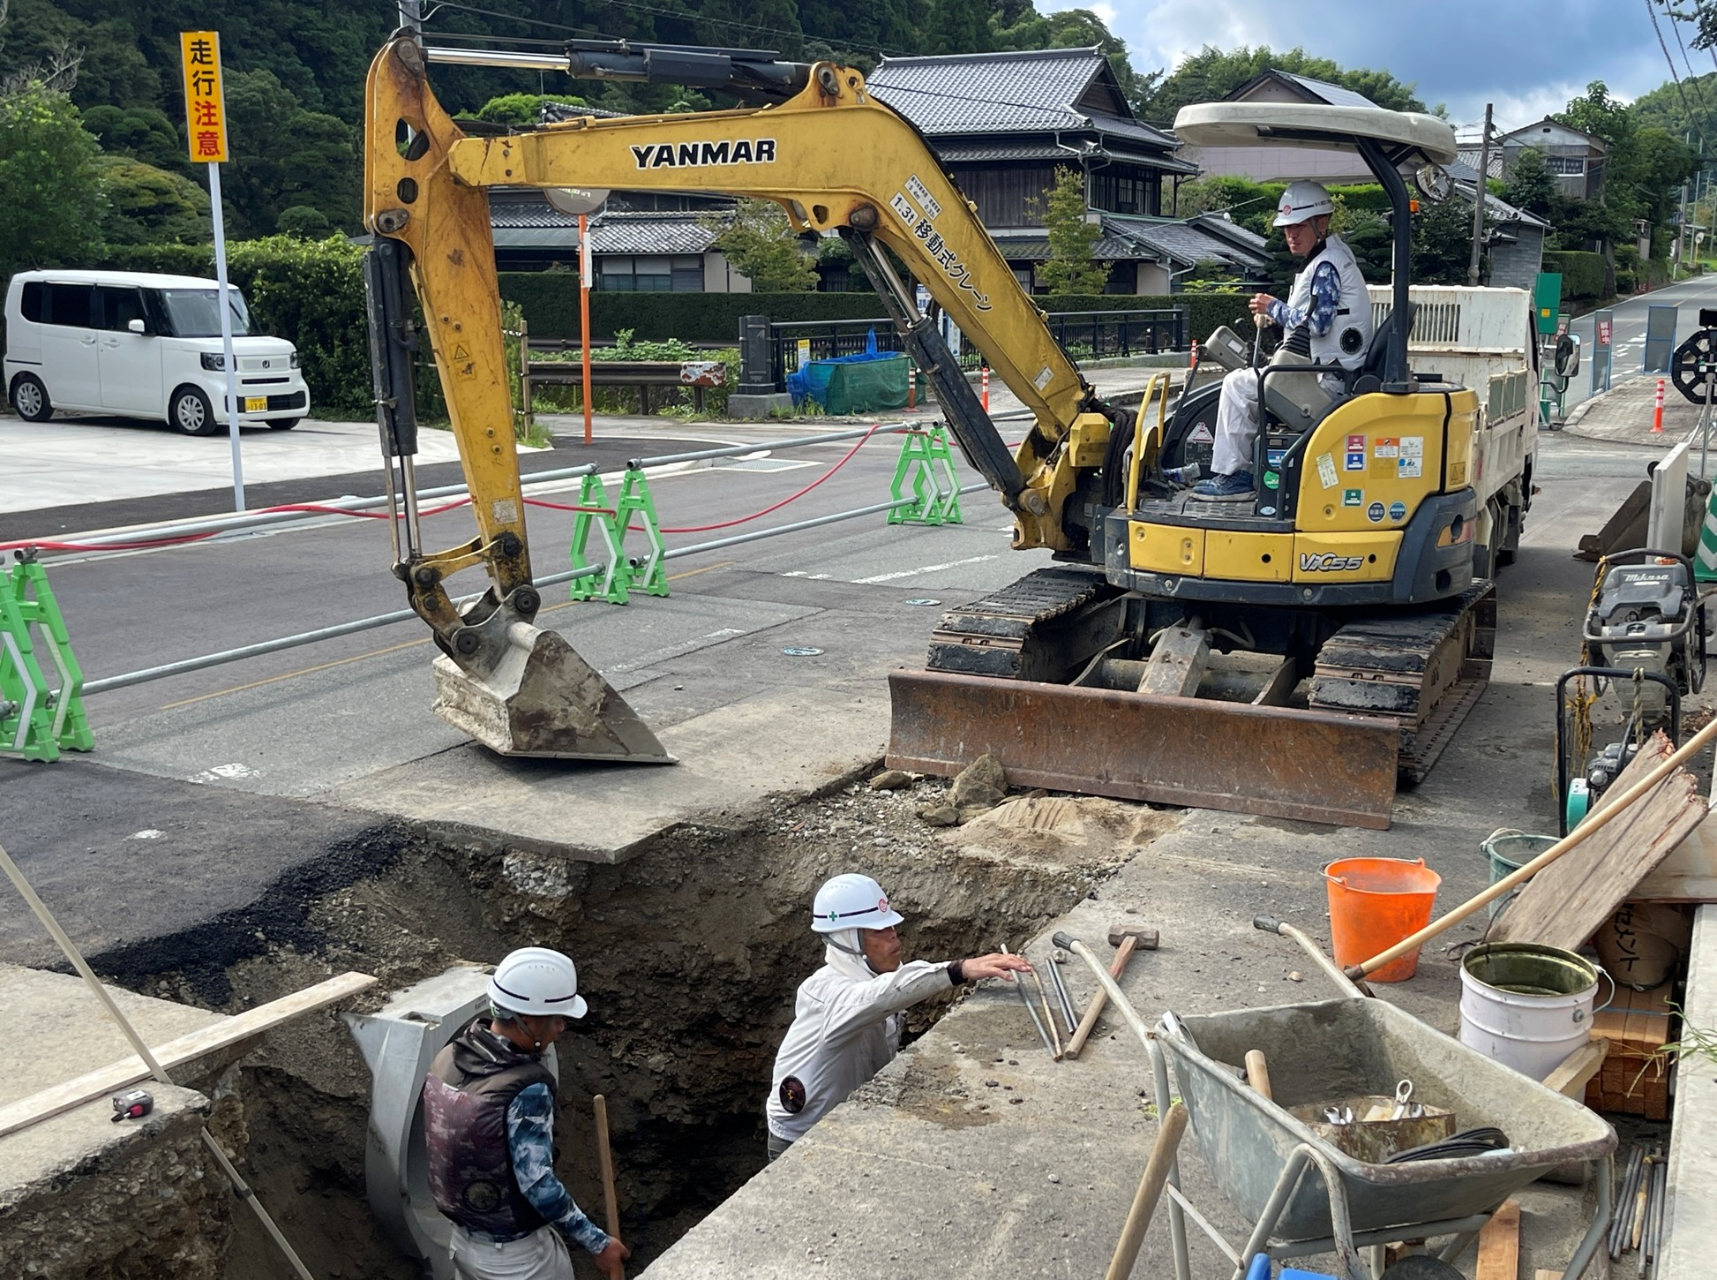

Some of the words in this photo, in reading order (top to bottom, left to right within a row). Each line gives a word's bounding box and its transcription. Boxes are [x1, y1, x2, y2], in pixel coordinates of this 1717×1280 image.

[190, 39, 220, 156] 走行注意
[631, 139, 775, 168] YANMAR
[892, 196, 915, 224] 1.3t
[914, 218, 992, 311] 移動式クレーン
[1623, 573, 1670, 582] Mikasa
